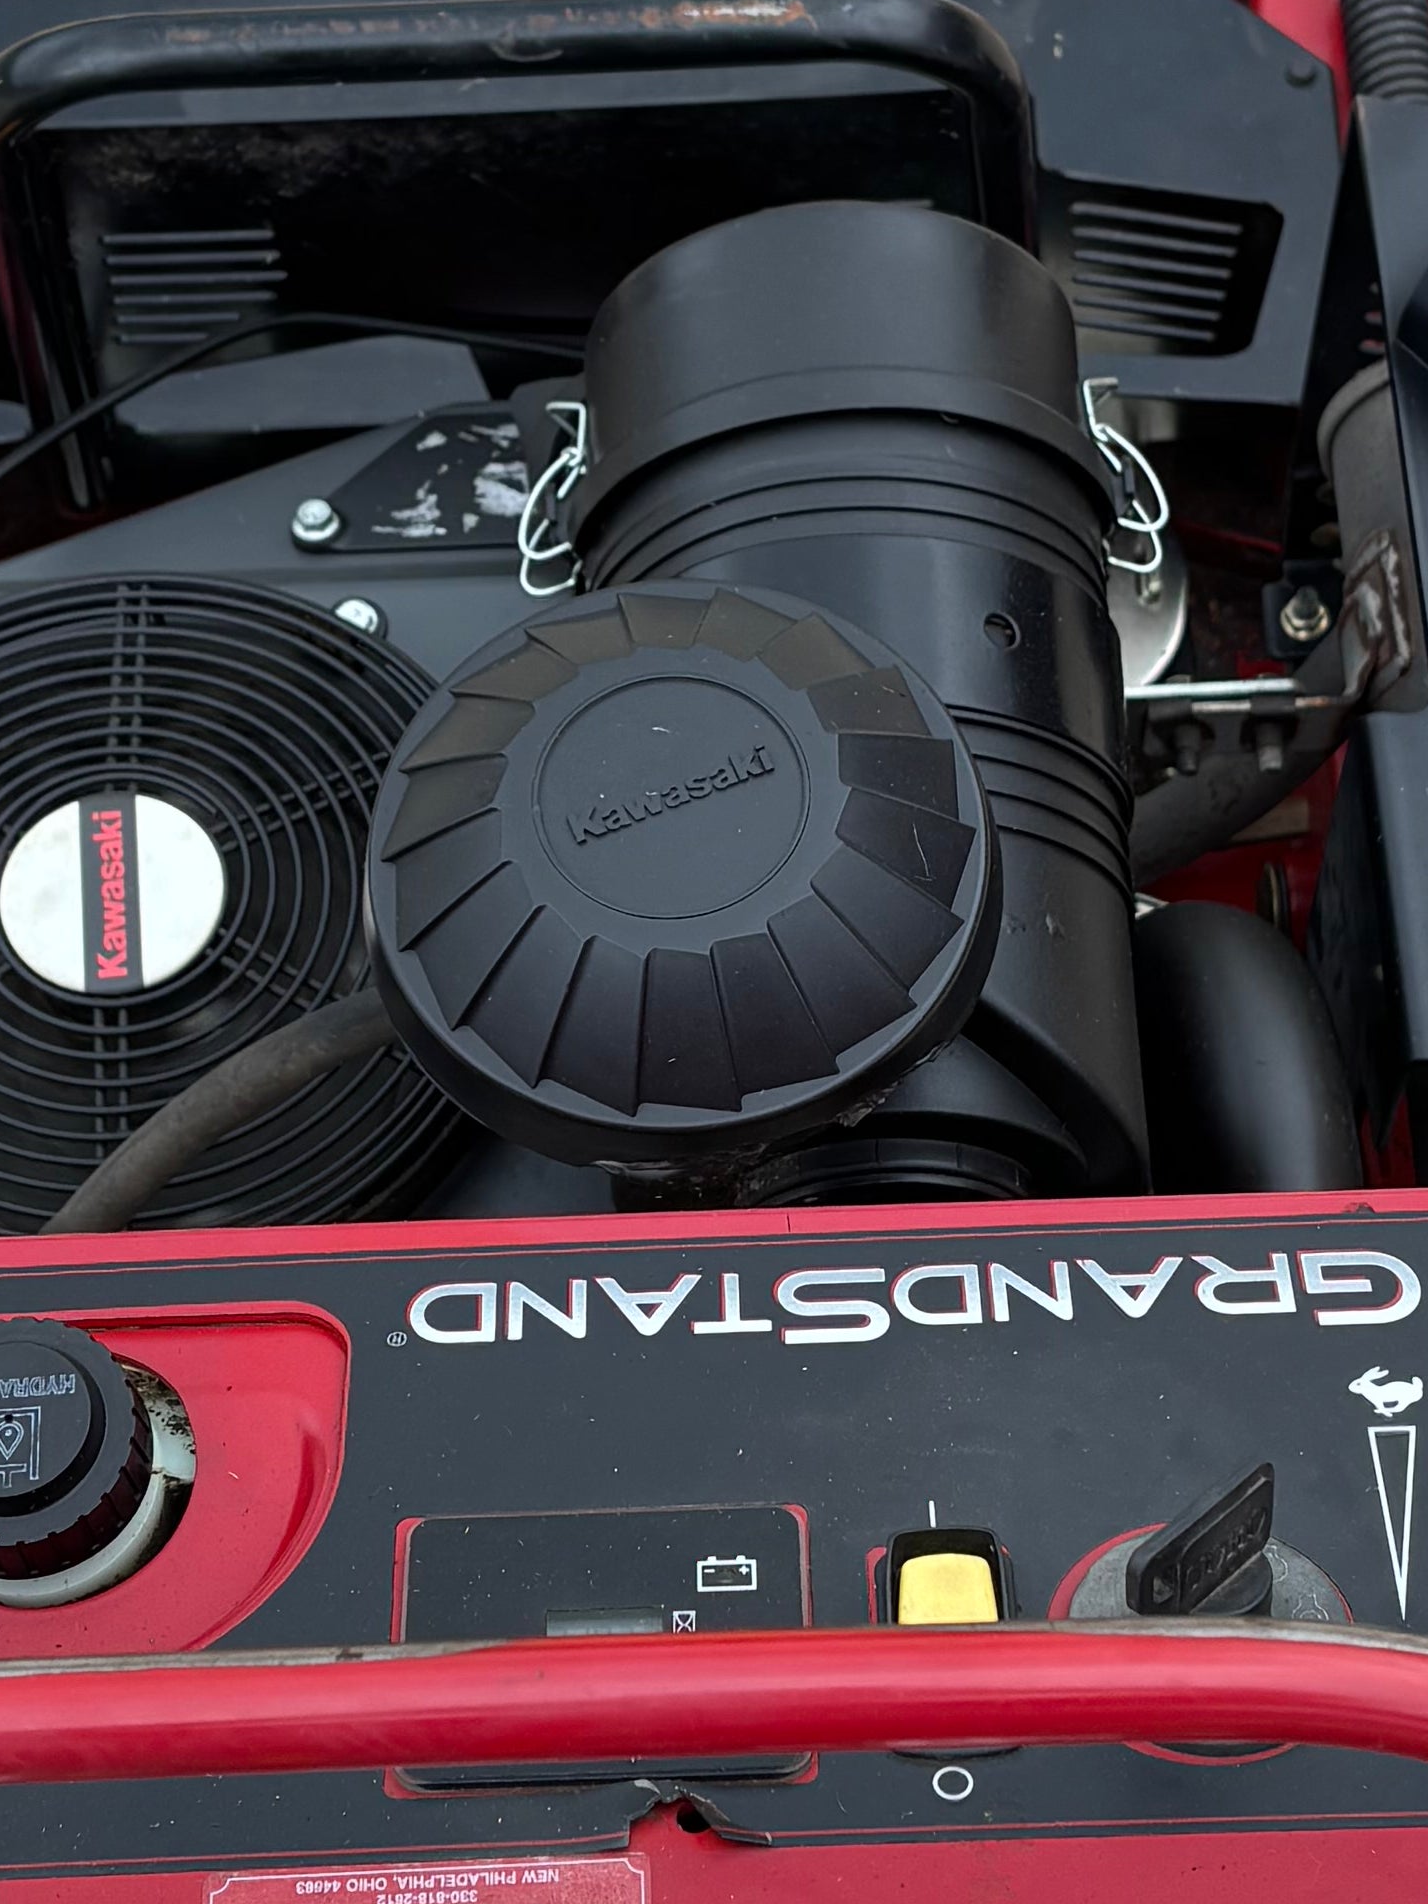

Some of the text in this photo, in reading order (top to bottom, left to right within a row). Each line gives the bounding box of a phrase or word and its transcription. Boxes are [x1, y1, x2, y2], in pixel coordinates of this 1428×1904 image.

[566, 744, 776, 844] Kawasaki
[91, 809, 128, 980] Kawasaki
[345, 1877, 388, 1892] OHIO
[392, 1870, 517, 1889] PHILADELPHIA,
[521, 1868, 560, 1883] NEW
